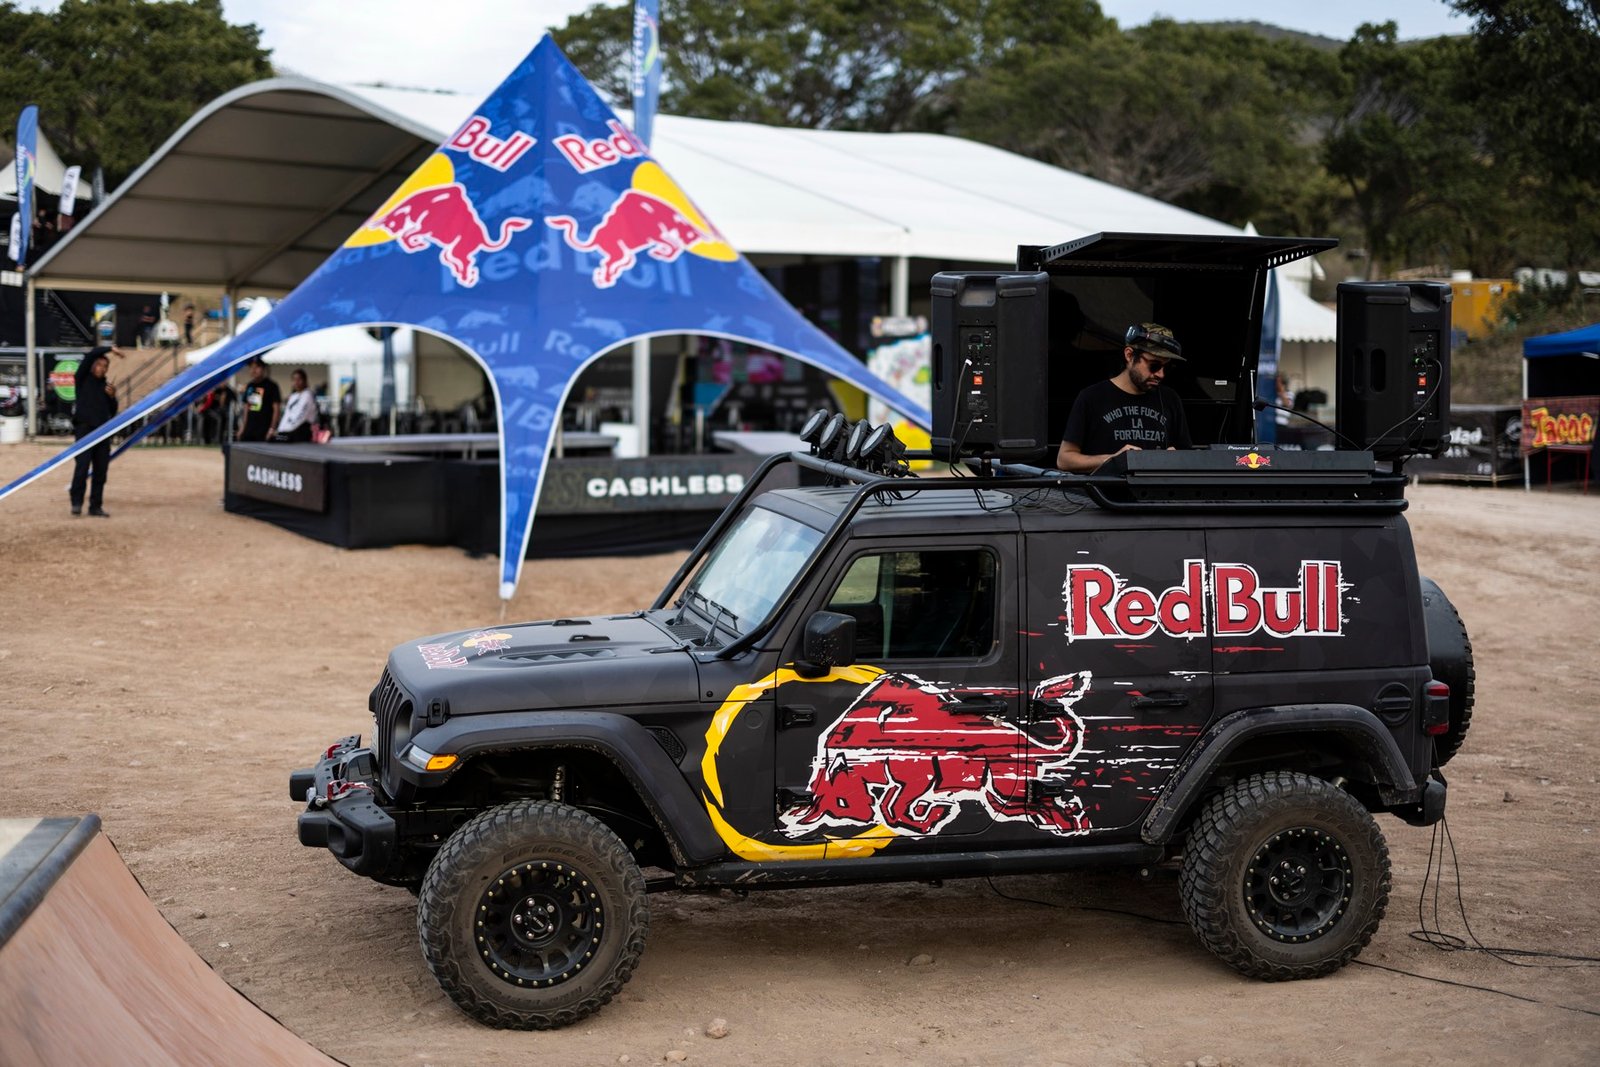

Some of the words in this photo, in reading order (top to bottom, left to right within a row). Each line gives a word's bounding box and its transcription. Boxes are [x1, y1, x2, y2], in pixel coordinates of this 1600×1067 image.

[447, 115, 538, 172] Bull
[552, 119, 649, 174] Red
[1103, 408, 1122, 424] WHO
[1122, 406, 1139, 415] THE
[1141, 406, 1159, 420] FUCK
[1131, 418, 1143, 429] LA
[1114, 430, 1166, 441] FORTALEZA?
[247, 464, 303, 492] CASHLESS
[587, 474, 744, 497] CASHLESS
[1065, 558, 1207, 640] Red
[1210, 559, 1344, 638] Bull
